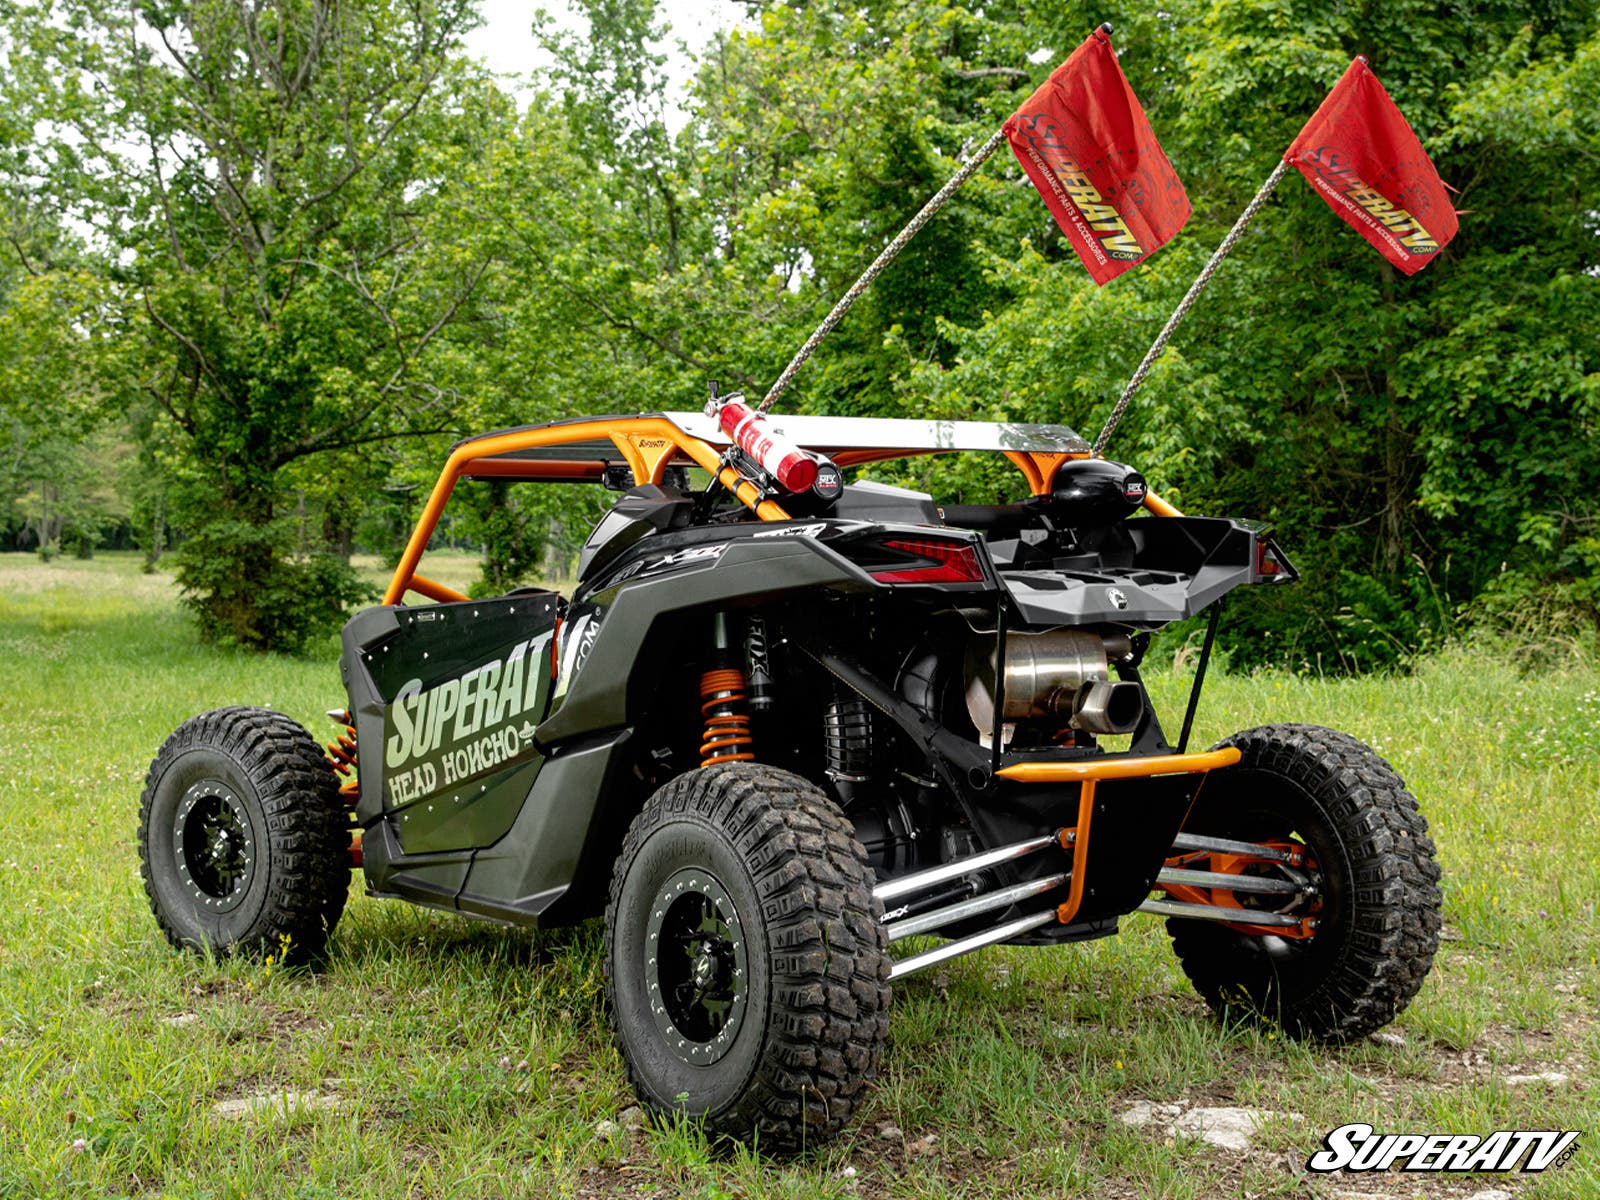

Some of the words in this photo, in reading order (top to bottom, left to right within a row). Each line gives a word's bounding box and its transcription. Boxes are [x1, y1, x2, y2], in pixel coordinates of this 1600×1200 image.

[1017, 113, 1143, 255] SUPERATV
[1026, 148, 1062, 196] PERFORMANCE
[1058, 194, 1076, 217] PARTS
[1075, 221, 1108, 266] ACCESSORIES
[1302, 146, 1439, 247] SUPERATV
[1315, 177, 1356, 212] PERFORMANCE
[1353, 208, 1373, 225] PARTS
[1375, 226, 1410, 262] ACCESSORIES
[388, 762, 437, 807] HEAD
[442, 723, 520, 785] HONCHO
